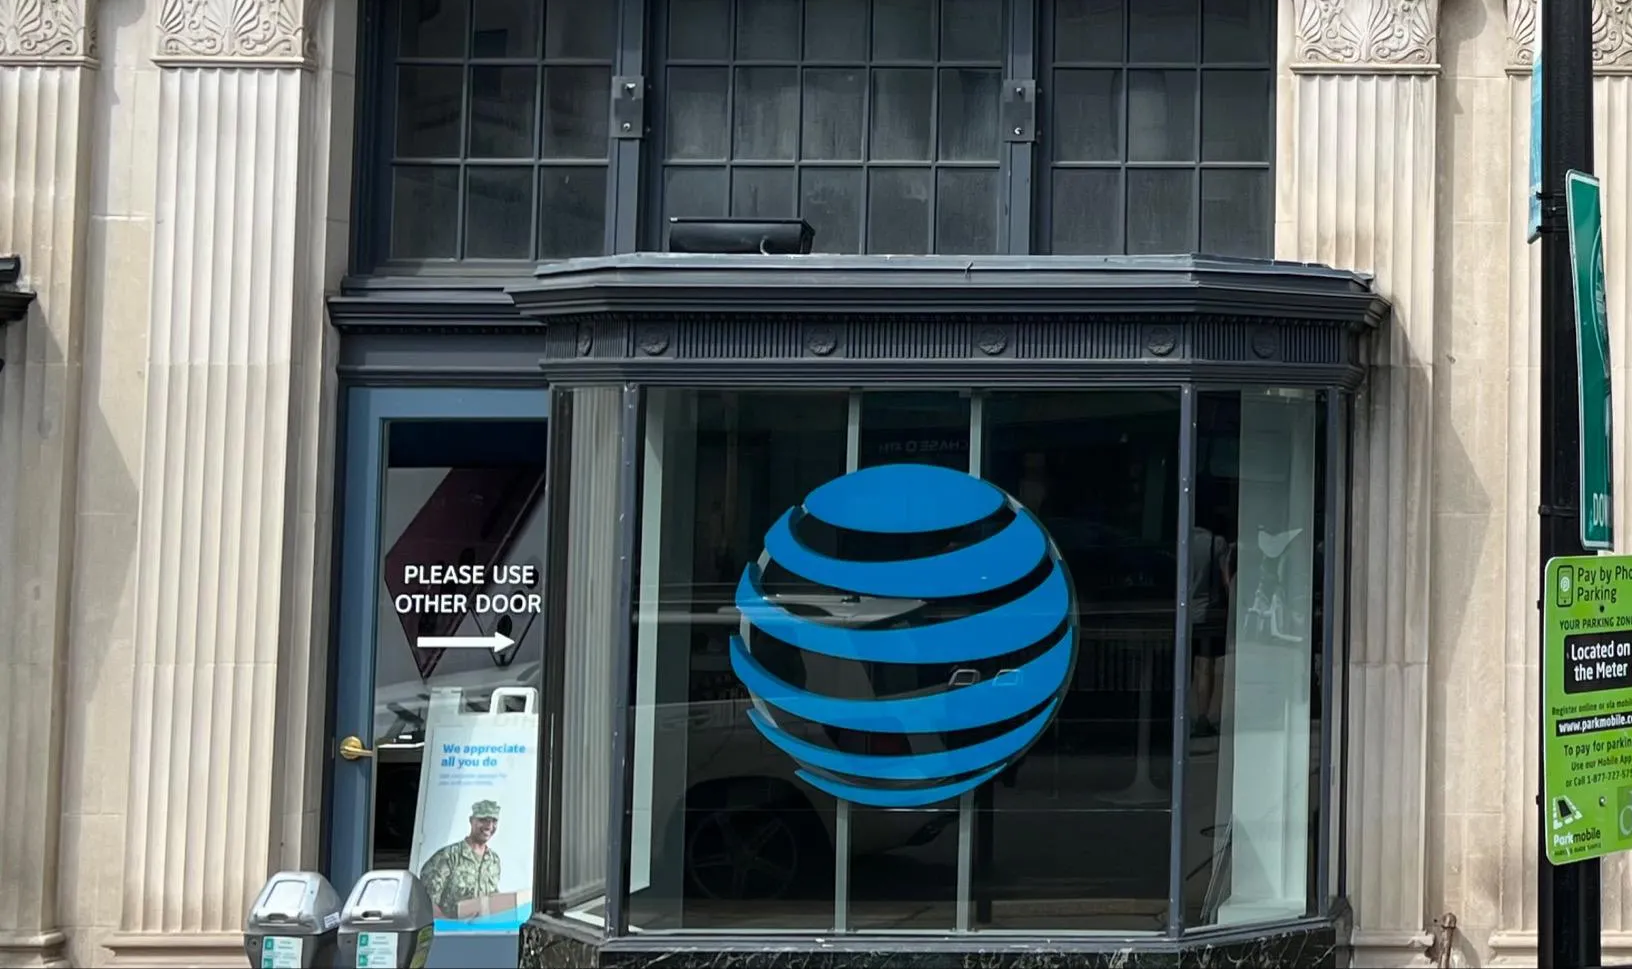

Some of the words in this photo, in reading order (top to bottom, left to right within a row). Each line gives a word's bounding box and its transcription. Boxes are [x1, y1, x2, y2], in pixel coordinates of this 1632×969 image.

[404, 565, 485, 584] PLEASE
[493, 565, 535, 584] USE
[1577, 567, 1596, 585] Pay
[1600, 566, 1612, 584] by
[1577, 586, 1617, 603] Parking
[395, 594, 467, 613] OTHER
[475, 594, 541, 613] DOOR
[1560, 618, 1580, 630] YOUR
[1582, 616, 1614, 629] PARKING
[1571, 640, 1614, 661] Located
[1617, 642, 1631, 656] on
[1574, 663, 1593, 681] the
[1596, 661, 1628, 679] Meter
[1606, 700, 1615, 709] via
[443, 744, 460, 753] We
[463, 743, 526, 756] appreciate
[1564, 744, 1573, 756] To
[1575, 744, 1590, 757] pay
[1593, 740, 1605, 752] for
[441, 756, 455, 767] all
[458, 759, 480, 769] you
[482, 756, 497, 767] do
[1571, 762, 1584, 771] Use
[1585, 761, 1596, 770] our
[1597, 757, 1618, 767] Mobile
[1620, 754, 1632, 764] App
[1565, 780, 1572, 788] or
[1574, 776, 1586, 787] Call
[1554, 827, 1600, 847] Parkmobile
